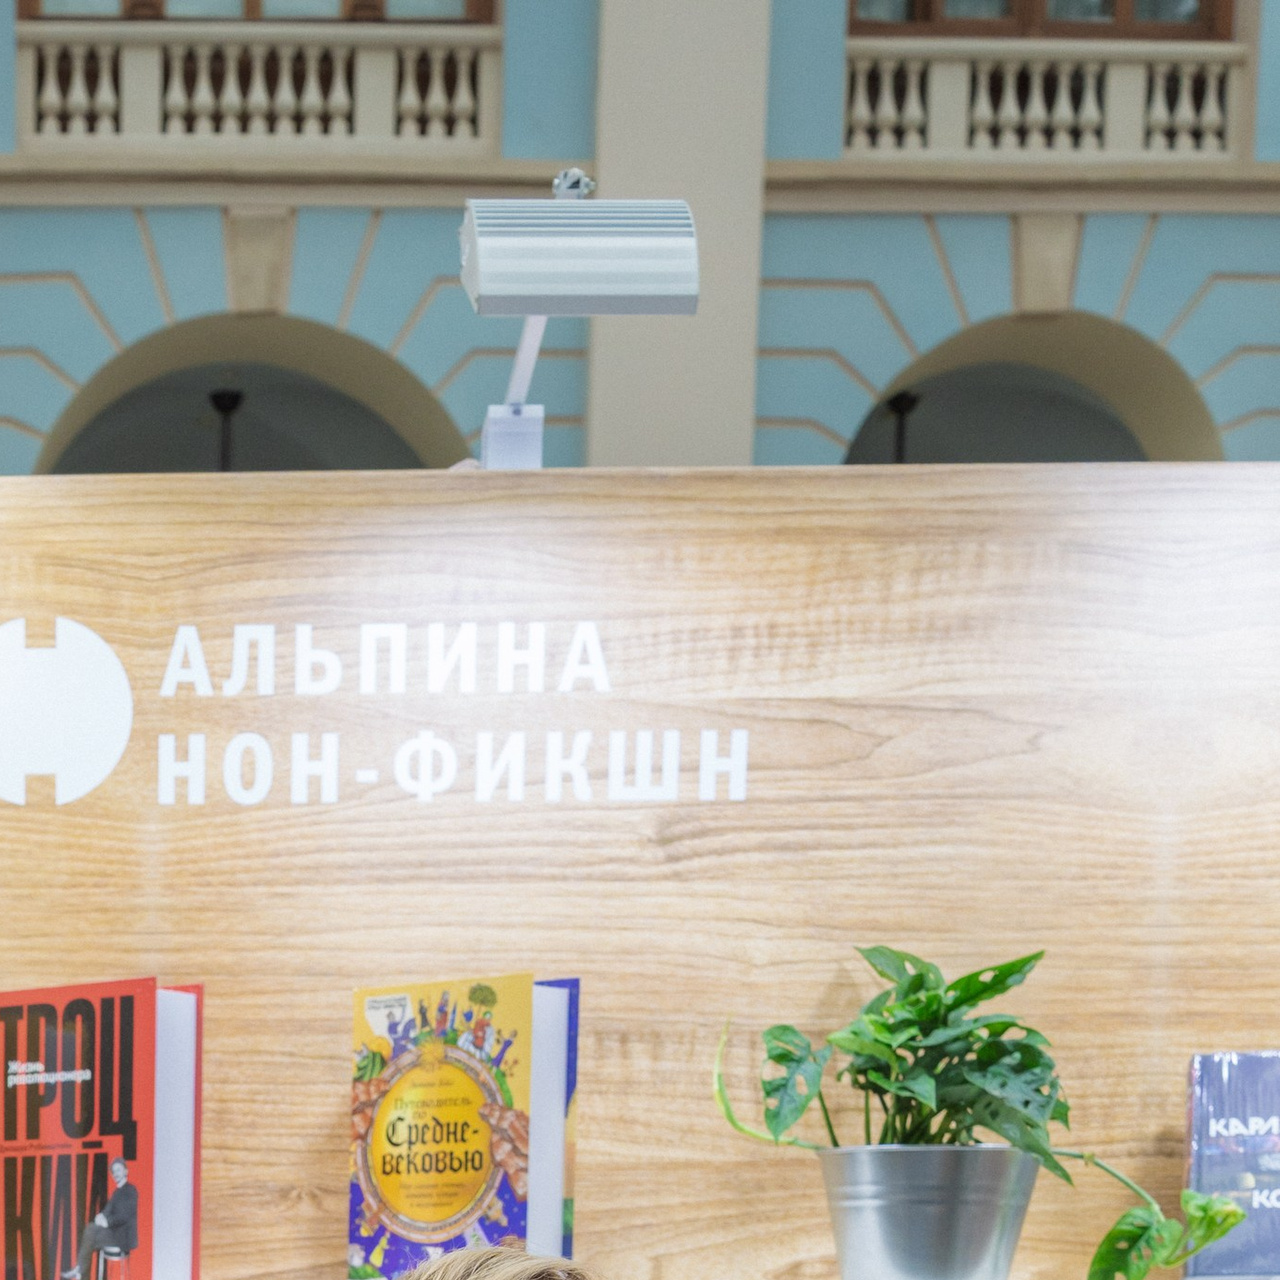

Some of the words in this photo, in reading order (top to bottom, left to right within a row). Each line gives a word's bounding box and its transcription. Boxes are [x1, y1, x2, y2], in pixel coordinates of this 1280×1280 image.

[160, 621, 612, 699] АЛЬПИНА
[158, 729, 749, 806] НОН-ФИКШН
[387, 1117, 479, 1150] Средне-
[382, 1150, 483, 1175] вековью
